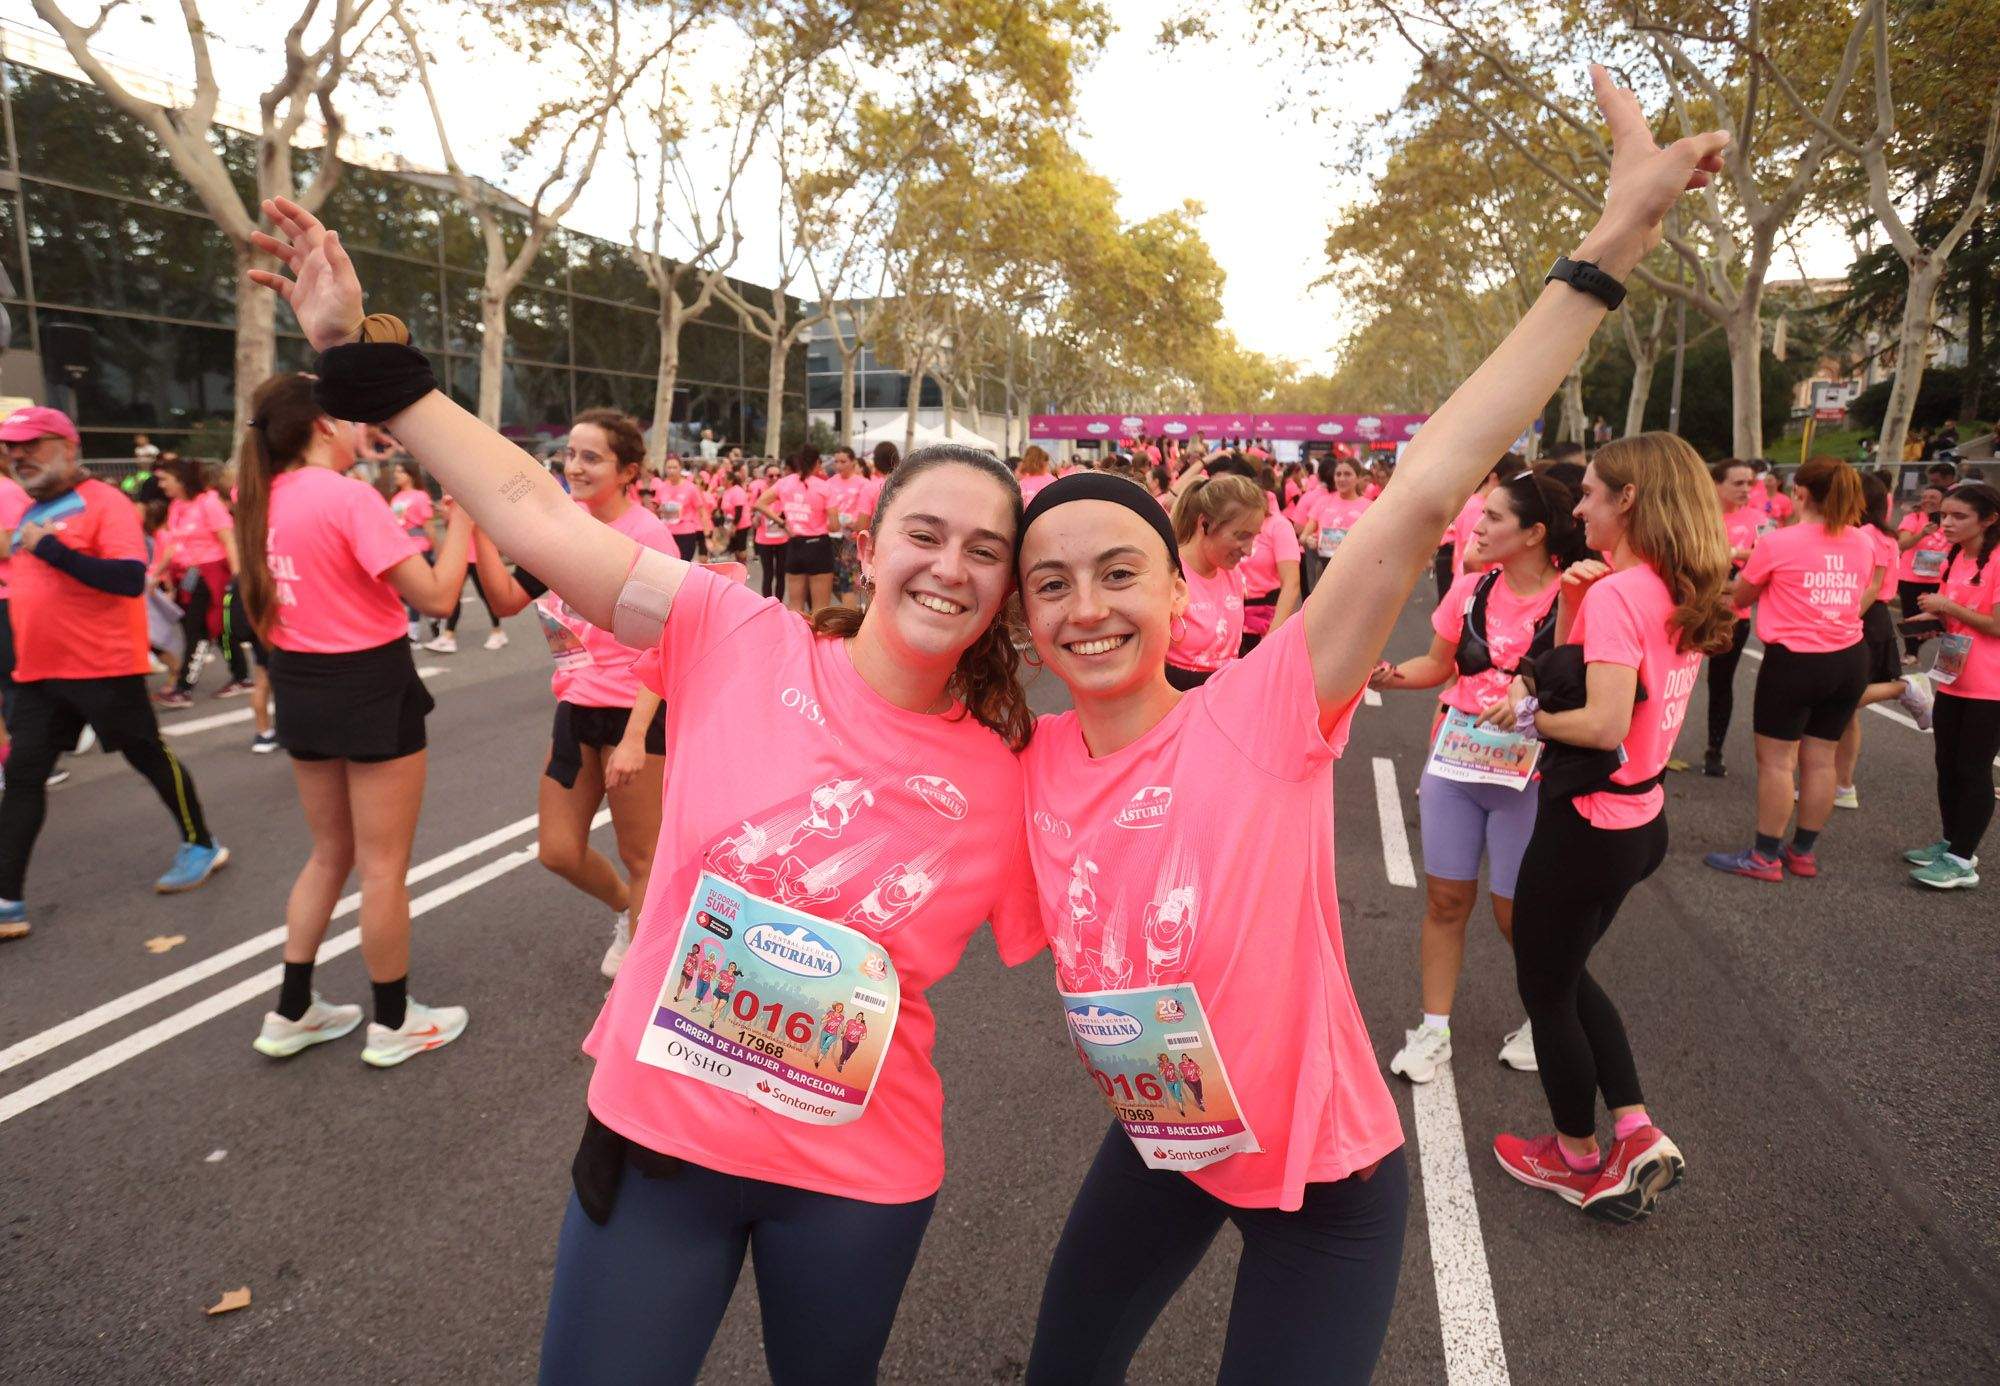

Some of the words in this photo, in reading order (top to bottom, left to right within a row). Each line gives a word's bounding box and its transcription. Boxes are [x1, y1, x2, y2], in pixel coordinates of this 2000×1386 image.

[1824, 554, 1844, 571] TU
[1803, 571, 1858, 589] DORSAL
[1809, 588, 1851, 605] SUMA
[1469, 742, 1504, 759] 016
[705, 897, 736, 921] SUMA
[718, 891, 741, 911] DORSAL
[749, 930, 833, 973] ASTURIANA
[1158, 999, 1178, 1014] 20
[732, 989, 815, 1044] 016
[1072, 1017, 1138, 1036] ASTURIANA
[738, 1030, 784, 1059] 17968
[667, 1041, 732, 1078] OYSHO
[674, 1018, 714, 1046] CARRERA
[716, 1041, 729, 1053] DE
[731, 1045, 744, 1059] LA
[746, 1051, 779, 1072] MUJER
[787, 1069, 846, 1098] BARCELONA
[1094, 1069, 1163, 1101] 016
[772, 1087, 837, 1118] Santander
[1115, 1106, 1155, 1121] 17969
[1130, 1124, 1160, 1135] MUJER
[1166, 1124, 1224, 1136] BARCELONA
[1167, 1145, 1232, 1161] Santander
